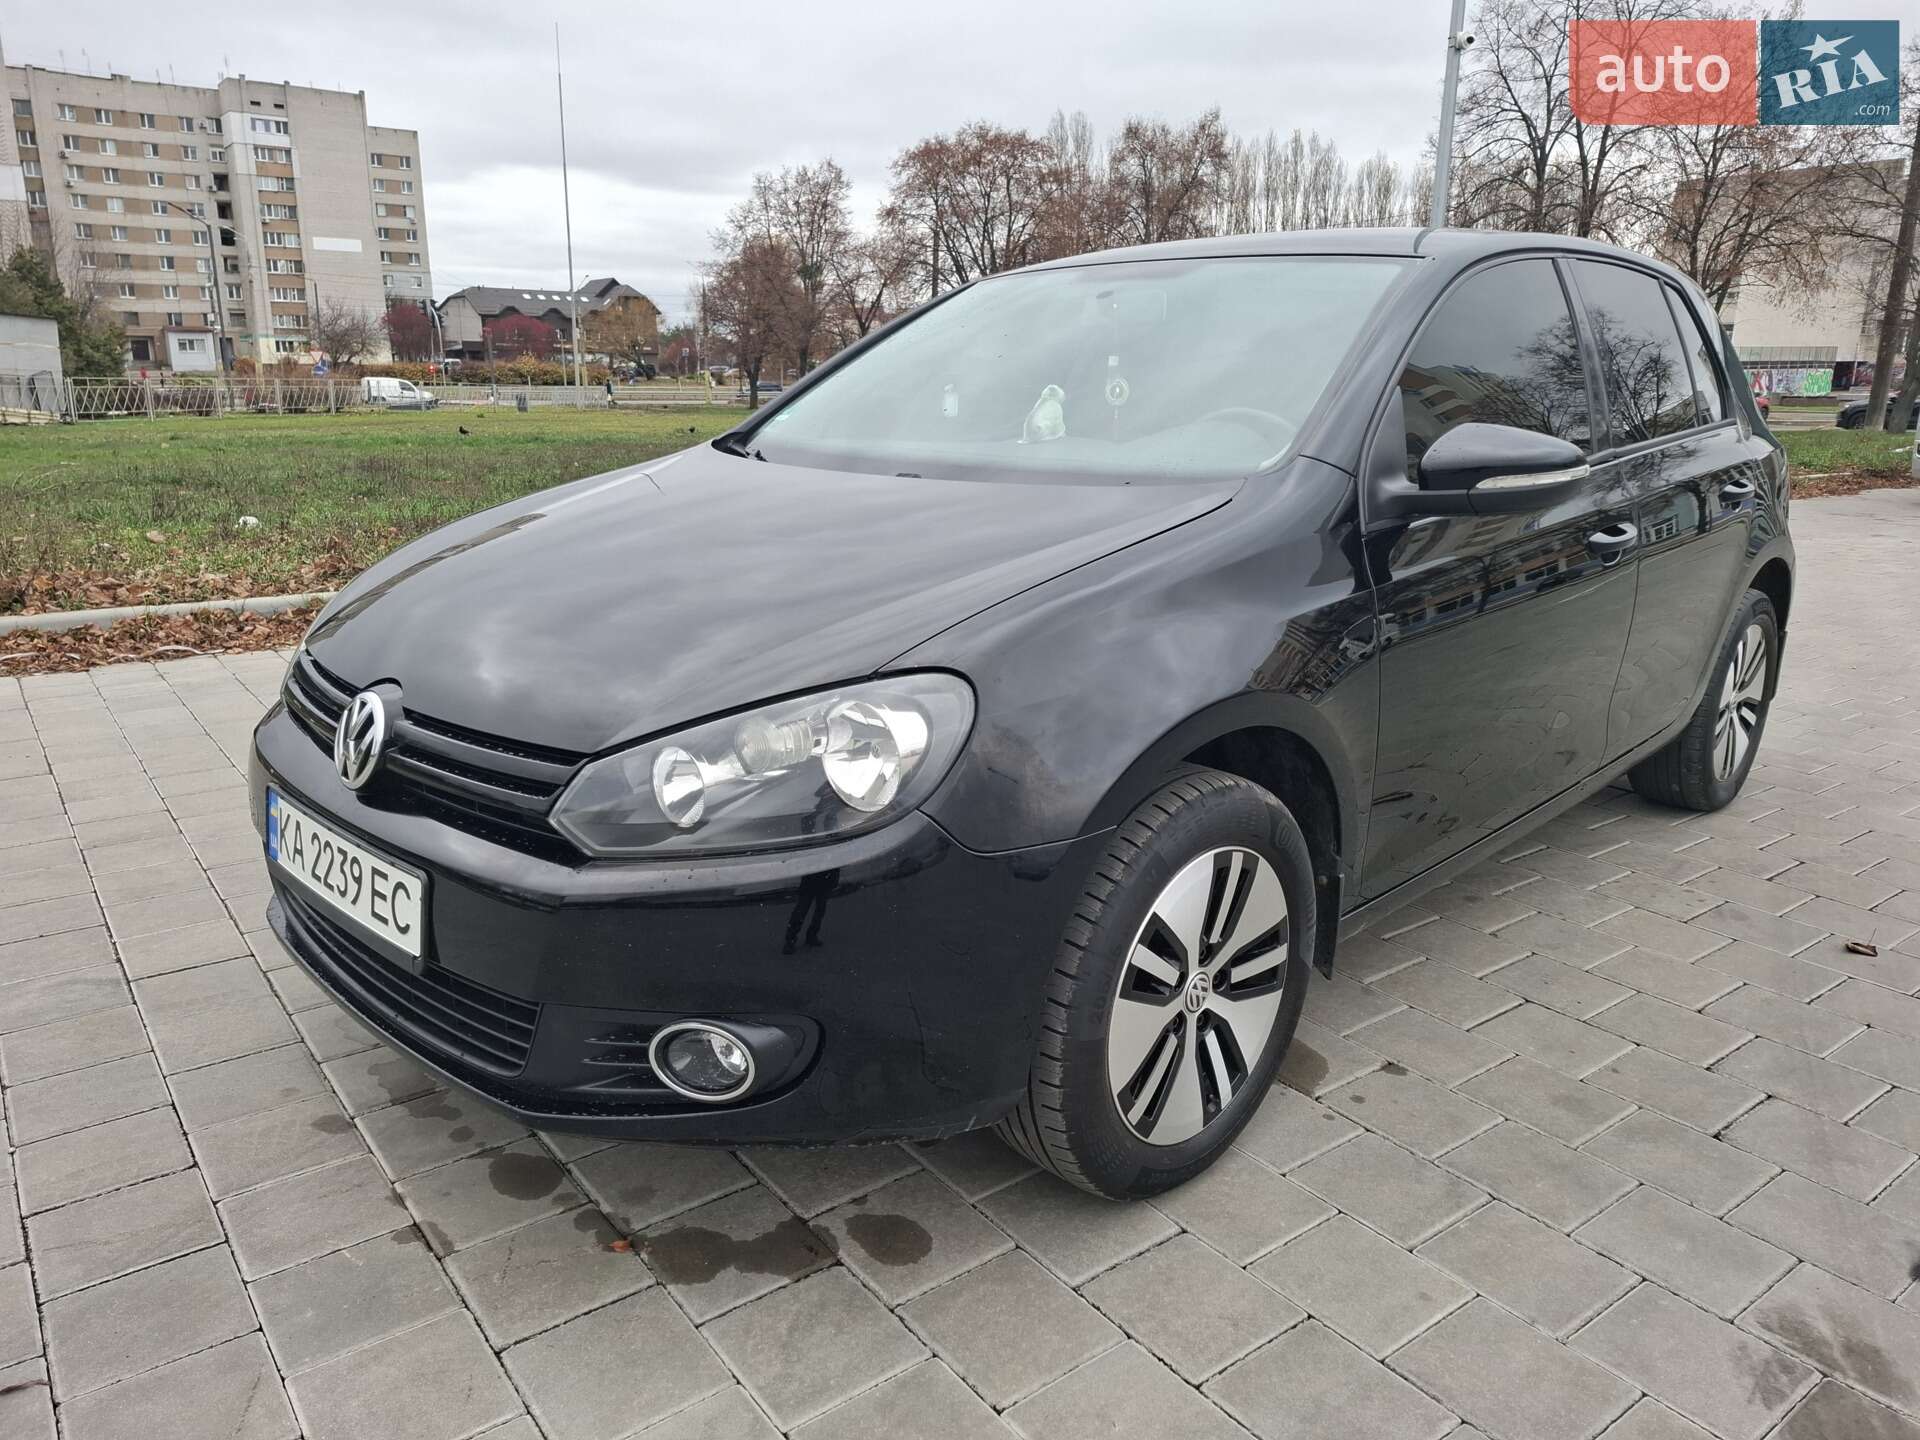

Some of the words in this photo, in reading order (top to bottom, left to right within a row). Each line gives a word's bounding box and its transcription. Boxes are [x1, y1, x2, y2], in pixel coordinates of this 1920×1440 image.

[279, 807, 305, 872] KA
[310, 831, 363, 906] 2239
[371, 866, 411, 935] EC
